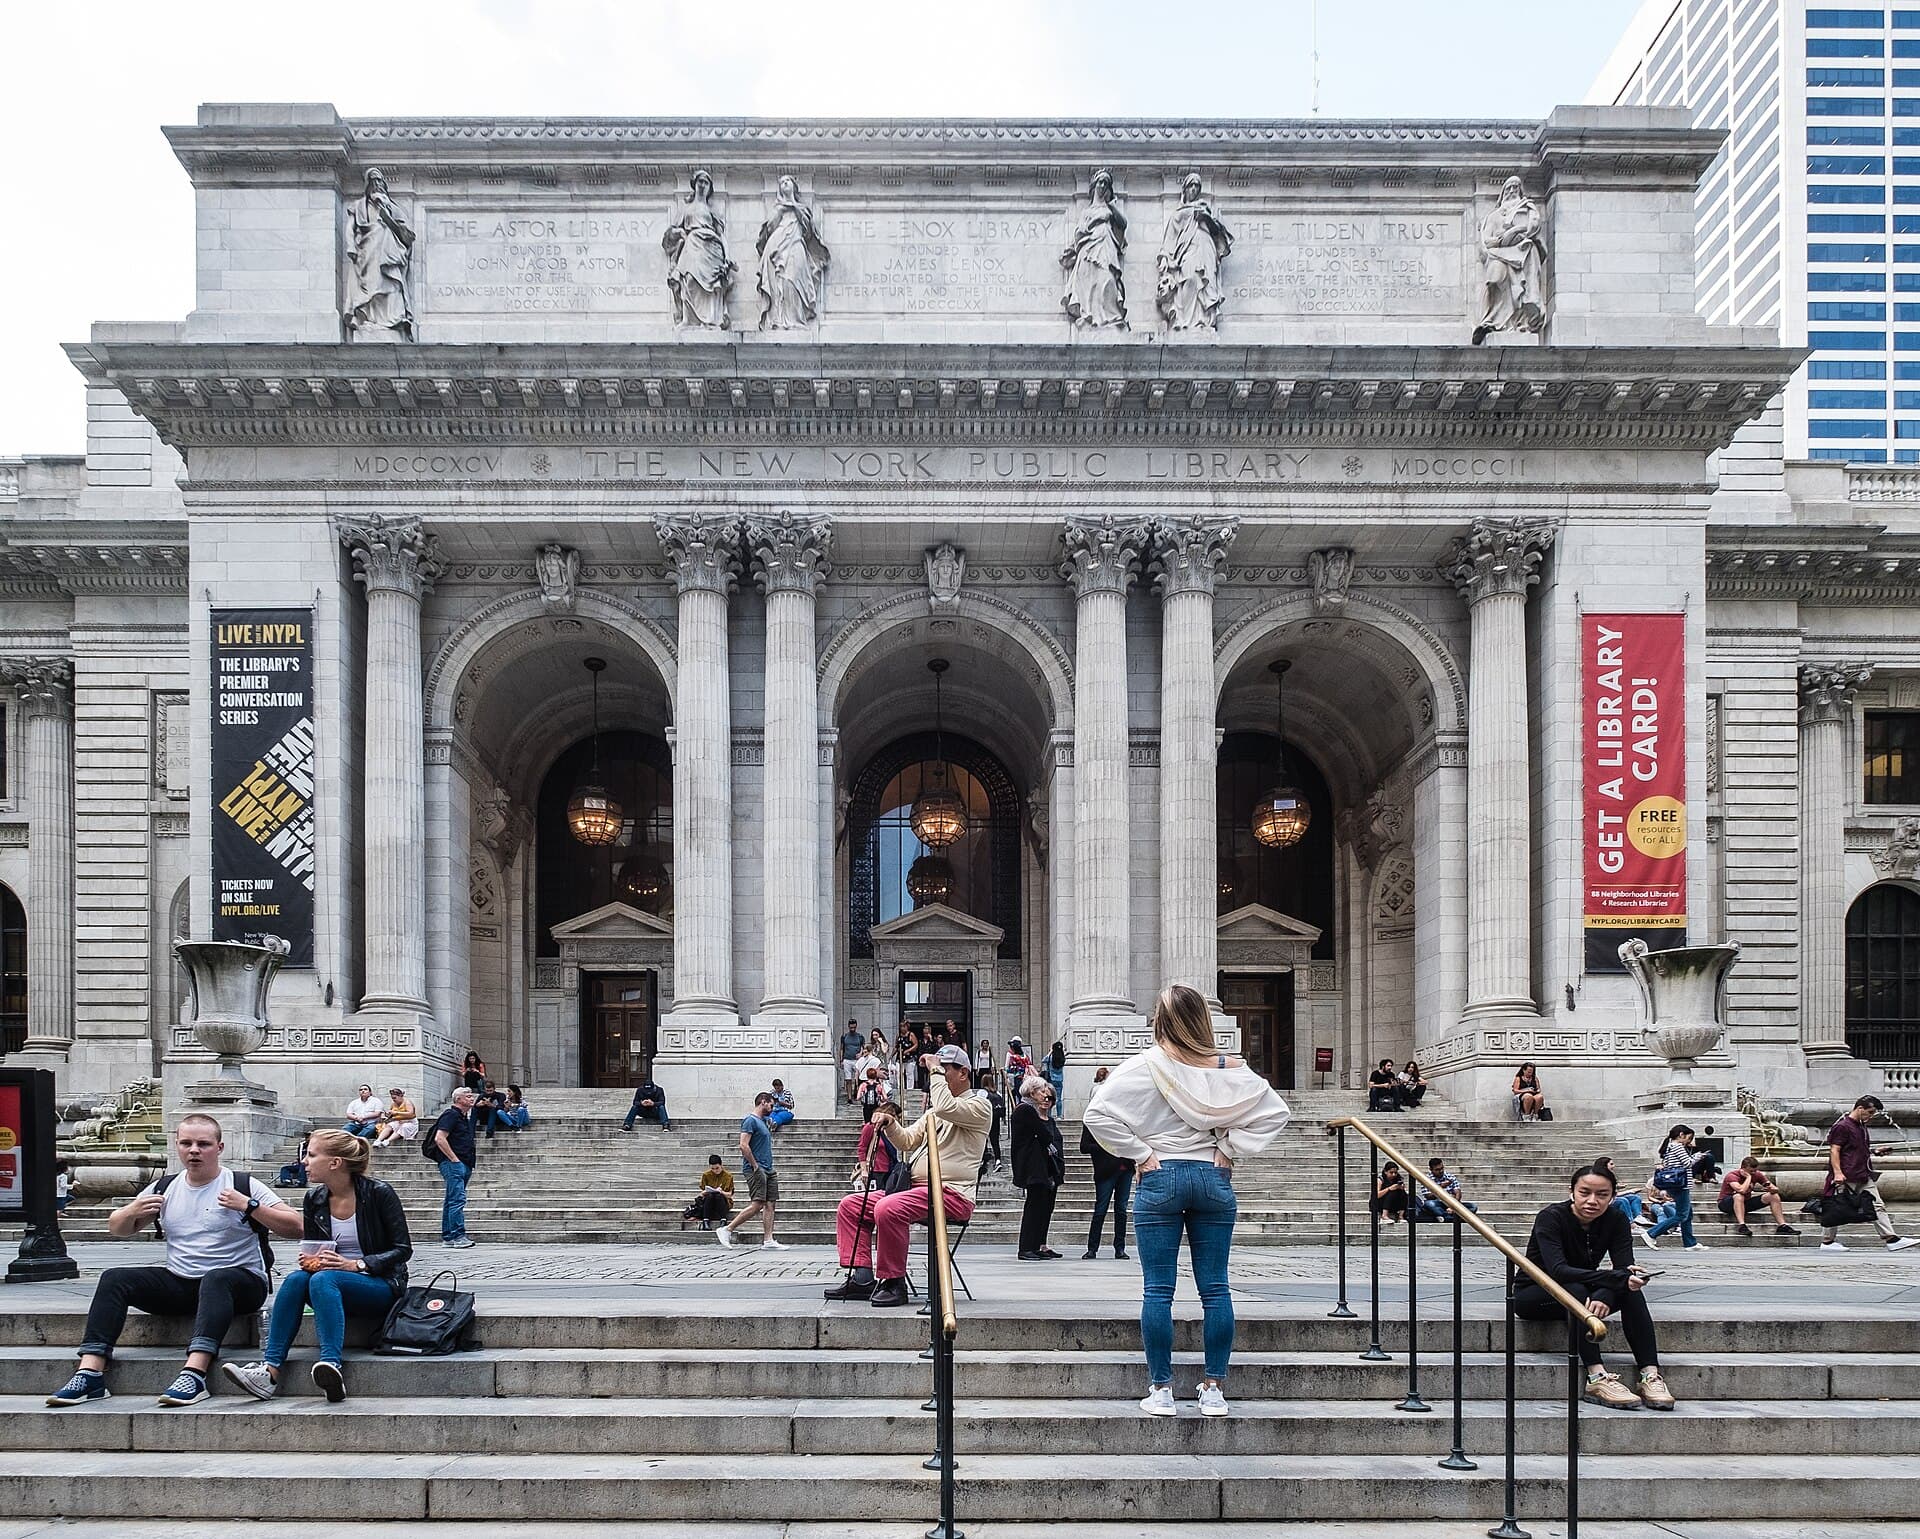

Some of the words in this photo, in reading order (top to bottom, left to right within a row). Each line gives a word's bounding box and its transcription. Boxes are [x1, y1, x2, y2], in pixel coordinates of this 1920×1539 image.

[440, 221, 478, 237] THE
[493, 221, 557, 237] ASTOR
[569, 220, 654, 238] LIBRARY
[837, 221, 876, 238] THE
[887, 221, 955, 238] LENOX
[968, 221, 1052, 239] LIBRARY
[1234, 222, 1273, 240] THE
[1292, 223, 1365, 240] TILDEN
[1383, 223, 1448, 240] TRUST
[503, 246, 561, 255] FOUNDED
[576, 246, 589, 255] BY
[901, 246, 959, 256] FOUNDED
[974, 246, 988, 256] BY
[1298, 248, 1356, 257] FOUNDED
[1370, 247, 1384, 257] BY
[467, 258, 509, 271] JOHN
[517, 258, 568, 270] JACOB
[577, 258, 625, 270] ASTOR
[884, 258, 937, 270] JAMES
[952, 258, 1005, 270] LENOX
[1257, 260, 1314, 272] SAMUEL
[1321, 260, 1369, 272] JONES
[1376, 260, 1427, 273] TILDEN
[518, 273, 542, 283] FOR
[549, 273, 574, 283] THE
[865, 273, 933, 283] DEDICATED
[943, 273, 959, 284] TO
[969, 273, 1023, 284] HISTORY
[1271, 275, 1306, 285] SERVE
[1315, 275, 1339, 285] THE
[1345, 275, 1411, 286] INTERESTS
[1419, 275, 1433, 285] OF
[437, 286, 522, 296] ADVANCEMENT
[526, 286, 541, 296] OF
[547, 286, 587, 296] USEFUL
[590, 286, 660, 296] KNOWLEDGE
[834, 287, 913, 297] LITERATURE
[923, 287, 947, 297] AND
[957, 287, 980, 297] THE
[989, 287, 1015, 297] FINE
[1023, 287, 1054, 297] ARTS
[1233, 288, 1284, 298] SCIENCE
[1292, 288, 1316, 298] AND
[1322, 288, 1376, 298] POPULAR
[1383, 288, 1451, 298] EDUCATION
[353, 456, 500, 474] MDCCCXCV
[585, 452, 667, 476] THE
[699, 452, 796, 476] NEW
[831, 452, 936, 477] YORK
[968, 452, 1107, 478] PUBLIC
[1146, 453, 1312, 478] LIBRARY
[1392, 458, 1525, 476] MDCCCCII
[218, 625, 253, 644] LIVE
[262, 624, 305, 644] NYPL
[219, 658, 241, 671] THE
[243, 657, 300, 671] LIBRARY'S
[219, 675, 269, 689] PREMIER
[219, 693, 303, 707] CONVERSATION
[1597, 625, 1623, 767] LIBRARY
[219, 711, 259, 725] SERIES
[1632, 678, 1658, 781] CARD!
[241, 760, 304, 822] NYPL
[1598, 777, 1624, 800] A
[219, 785, 275, 839] LIVE
[1640, 810, 1677, 822] FREE
[1637, 826, 1681, 834] resources
[1598, 809, 1624, 873] GET
[1643, 836, 1656, 844] for
[1658, 836, 1676, 844] ALL
[221, 880, 253, 890] TICKETS
[254, 880, 274, 889] NOW
[221, 893, 232, 903] ON
[234, 892, 253, 903] SALE
[1601, 890, 1648, 898] Neighborhood
[1650, 890, 1679, 898] Libraries
[221, 904, 280, 916] NYPL.ORG/LIVE
